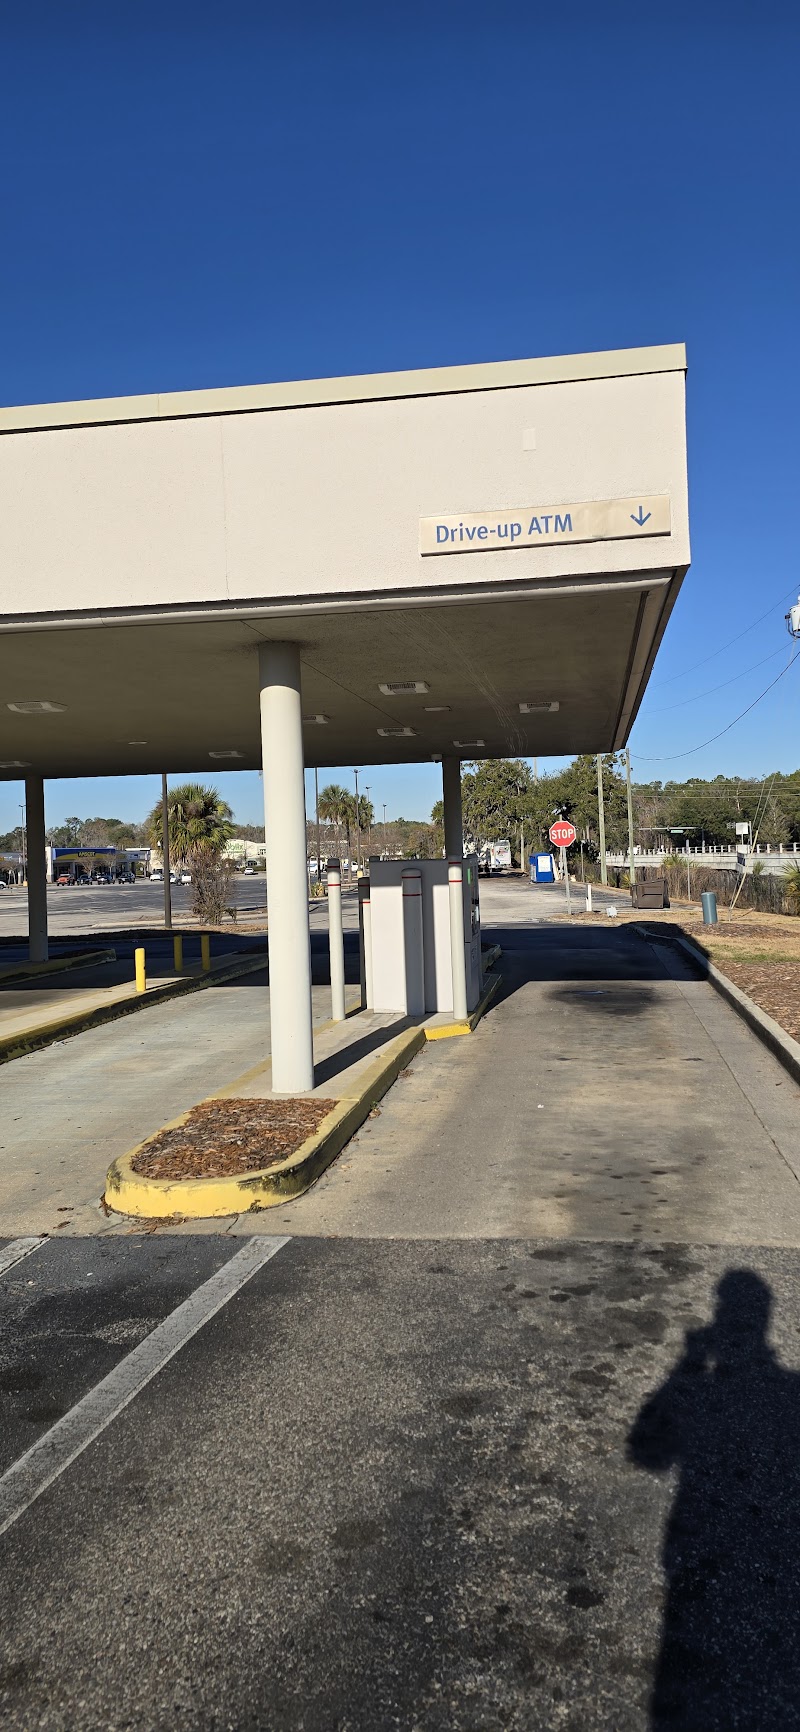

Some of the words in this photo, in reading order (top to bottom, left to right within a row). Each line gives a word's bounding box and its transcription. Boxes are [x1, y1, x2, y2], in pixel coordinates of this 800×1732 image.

[436, 522, 522, 543] Drive-up
[528, 513, 573, 535] ATM
[551, 828, 574, 840] STOP
